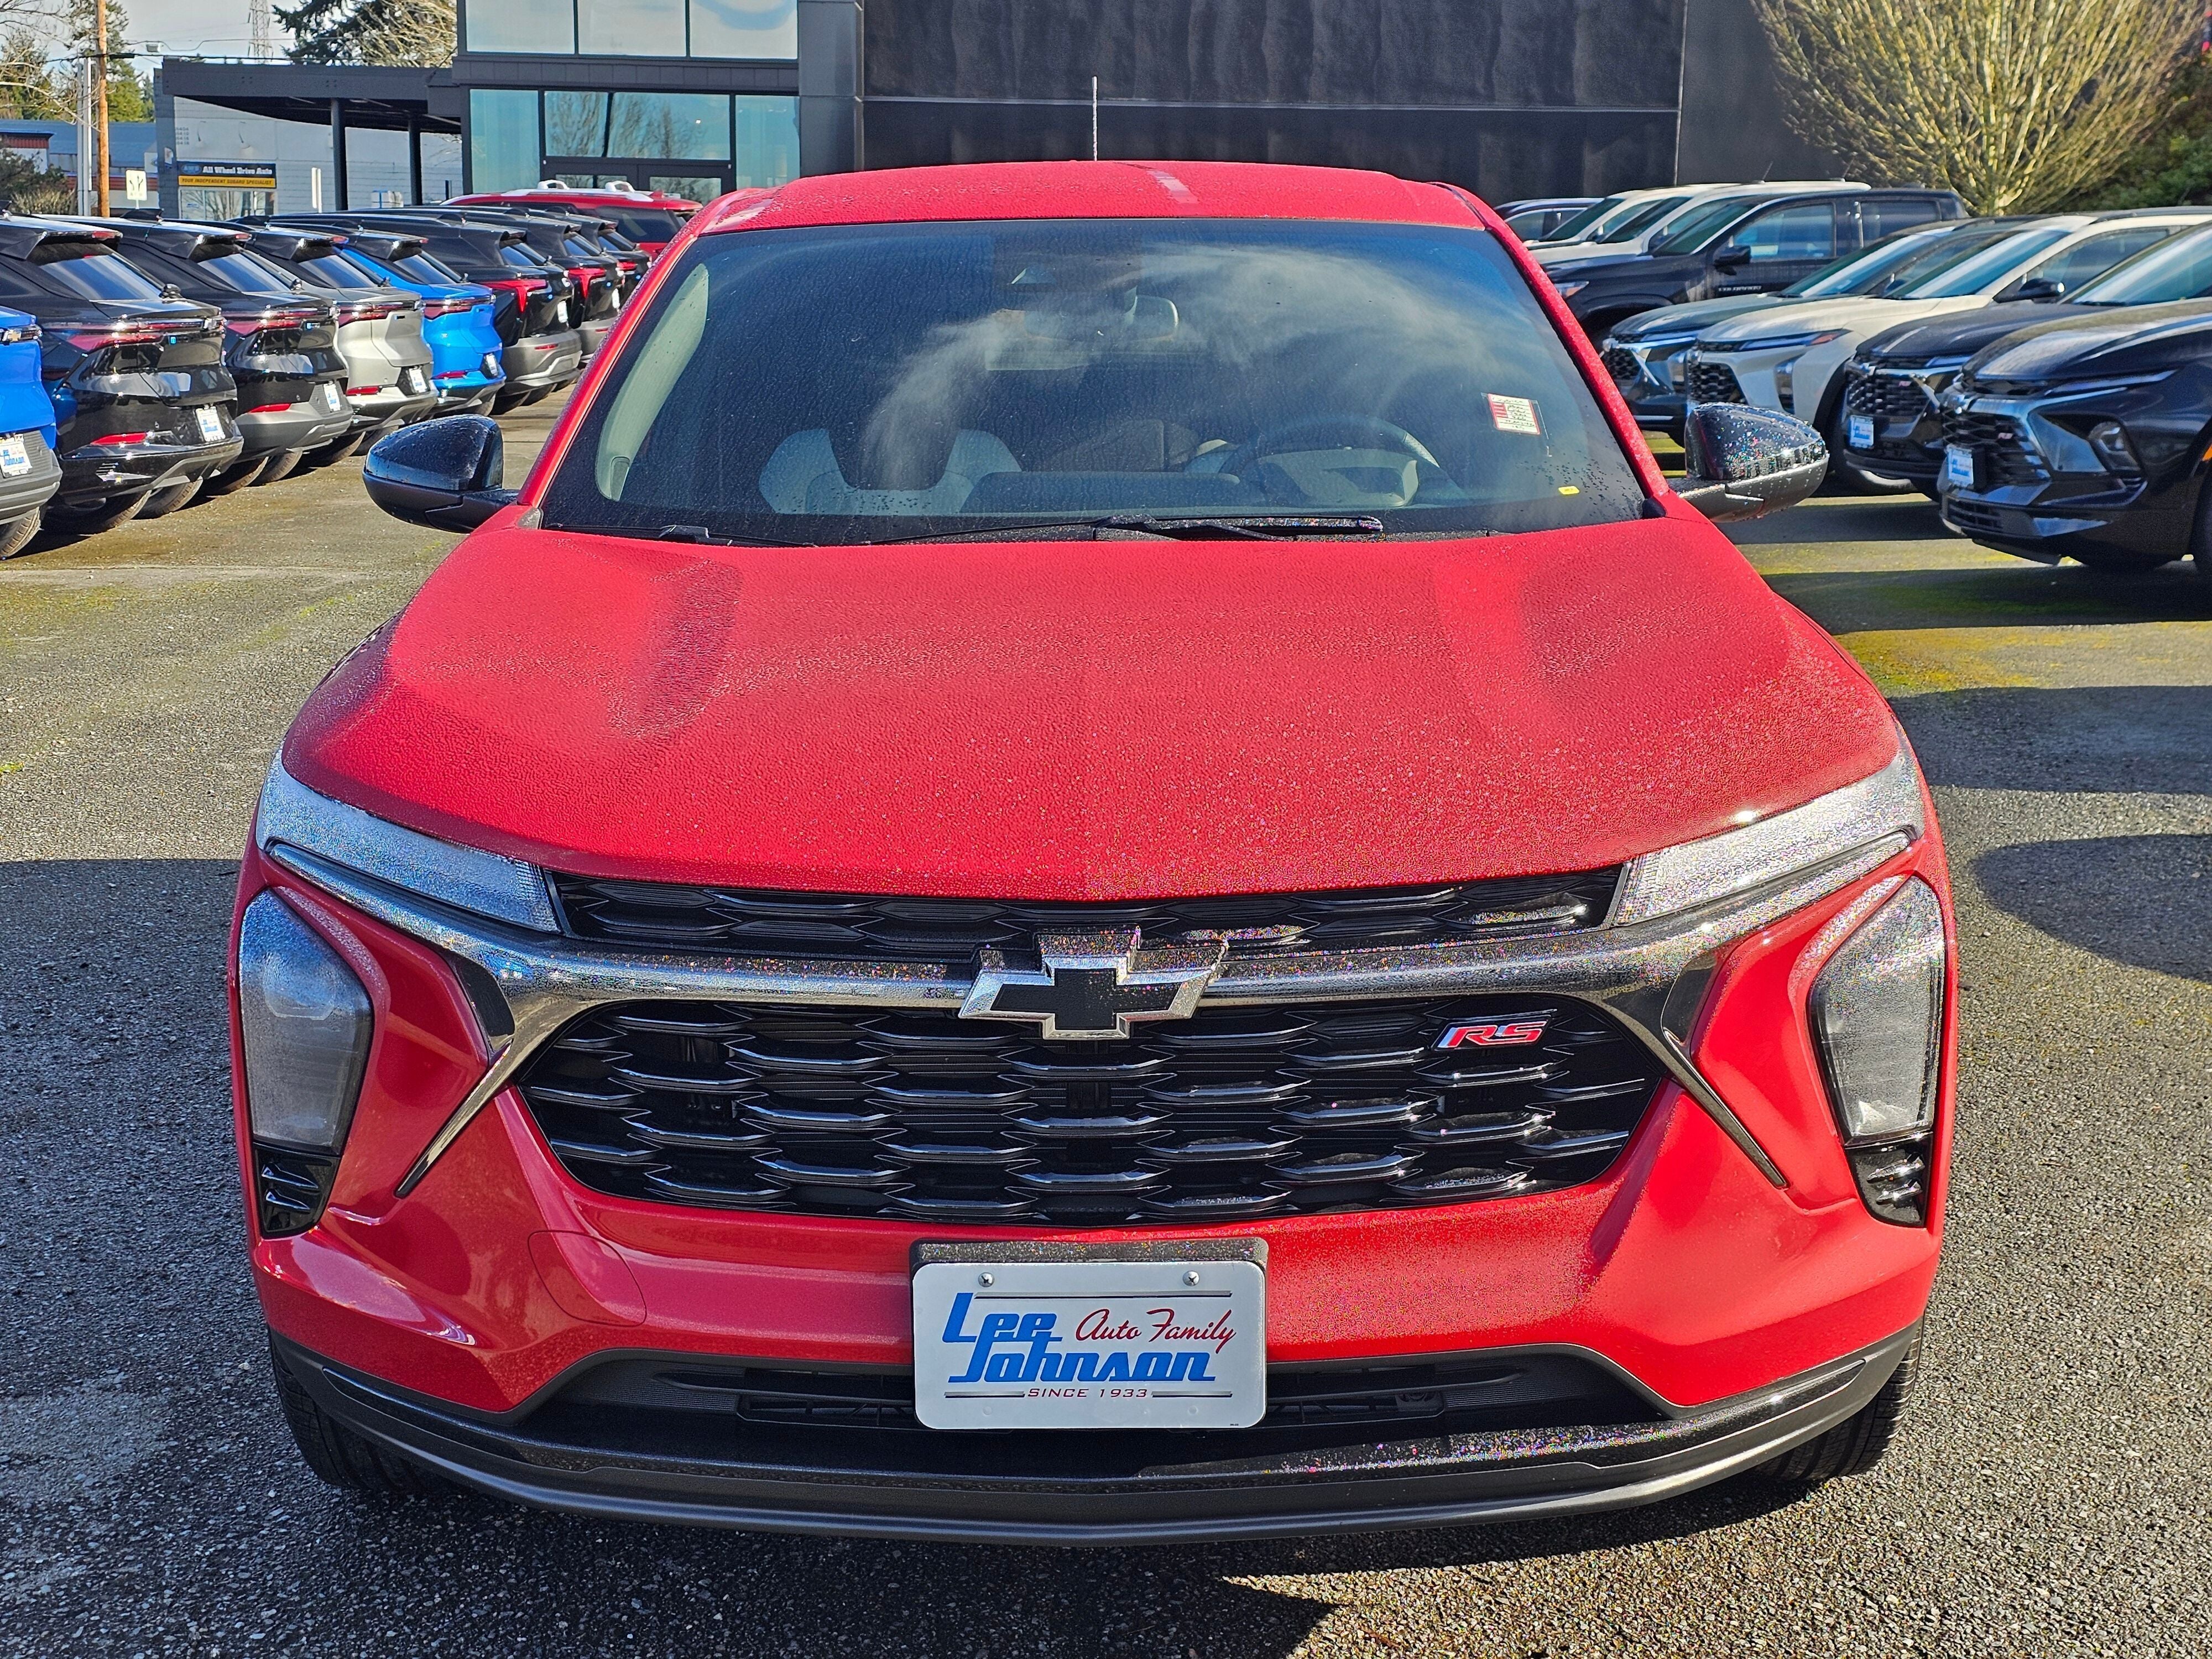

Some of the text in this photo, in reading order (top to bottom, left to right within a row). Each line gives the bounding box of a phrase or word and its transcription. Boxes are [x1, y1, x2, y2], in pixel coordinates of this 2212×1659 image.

[1437, 1021, 1547, 1048] RS
[942, 1292, 1062, 1343] Lee
[1076, 1308, 1237, 1354] Auto Family
[948, 1340, 1216, 1383] Johnson
[1027, 1388, 1148, 1399] SINCE 1933
